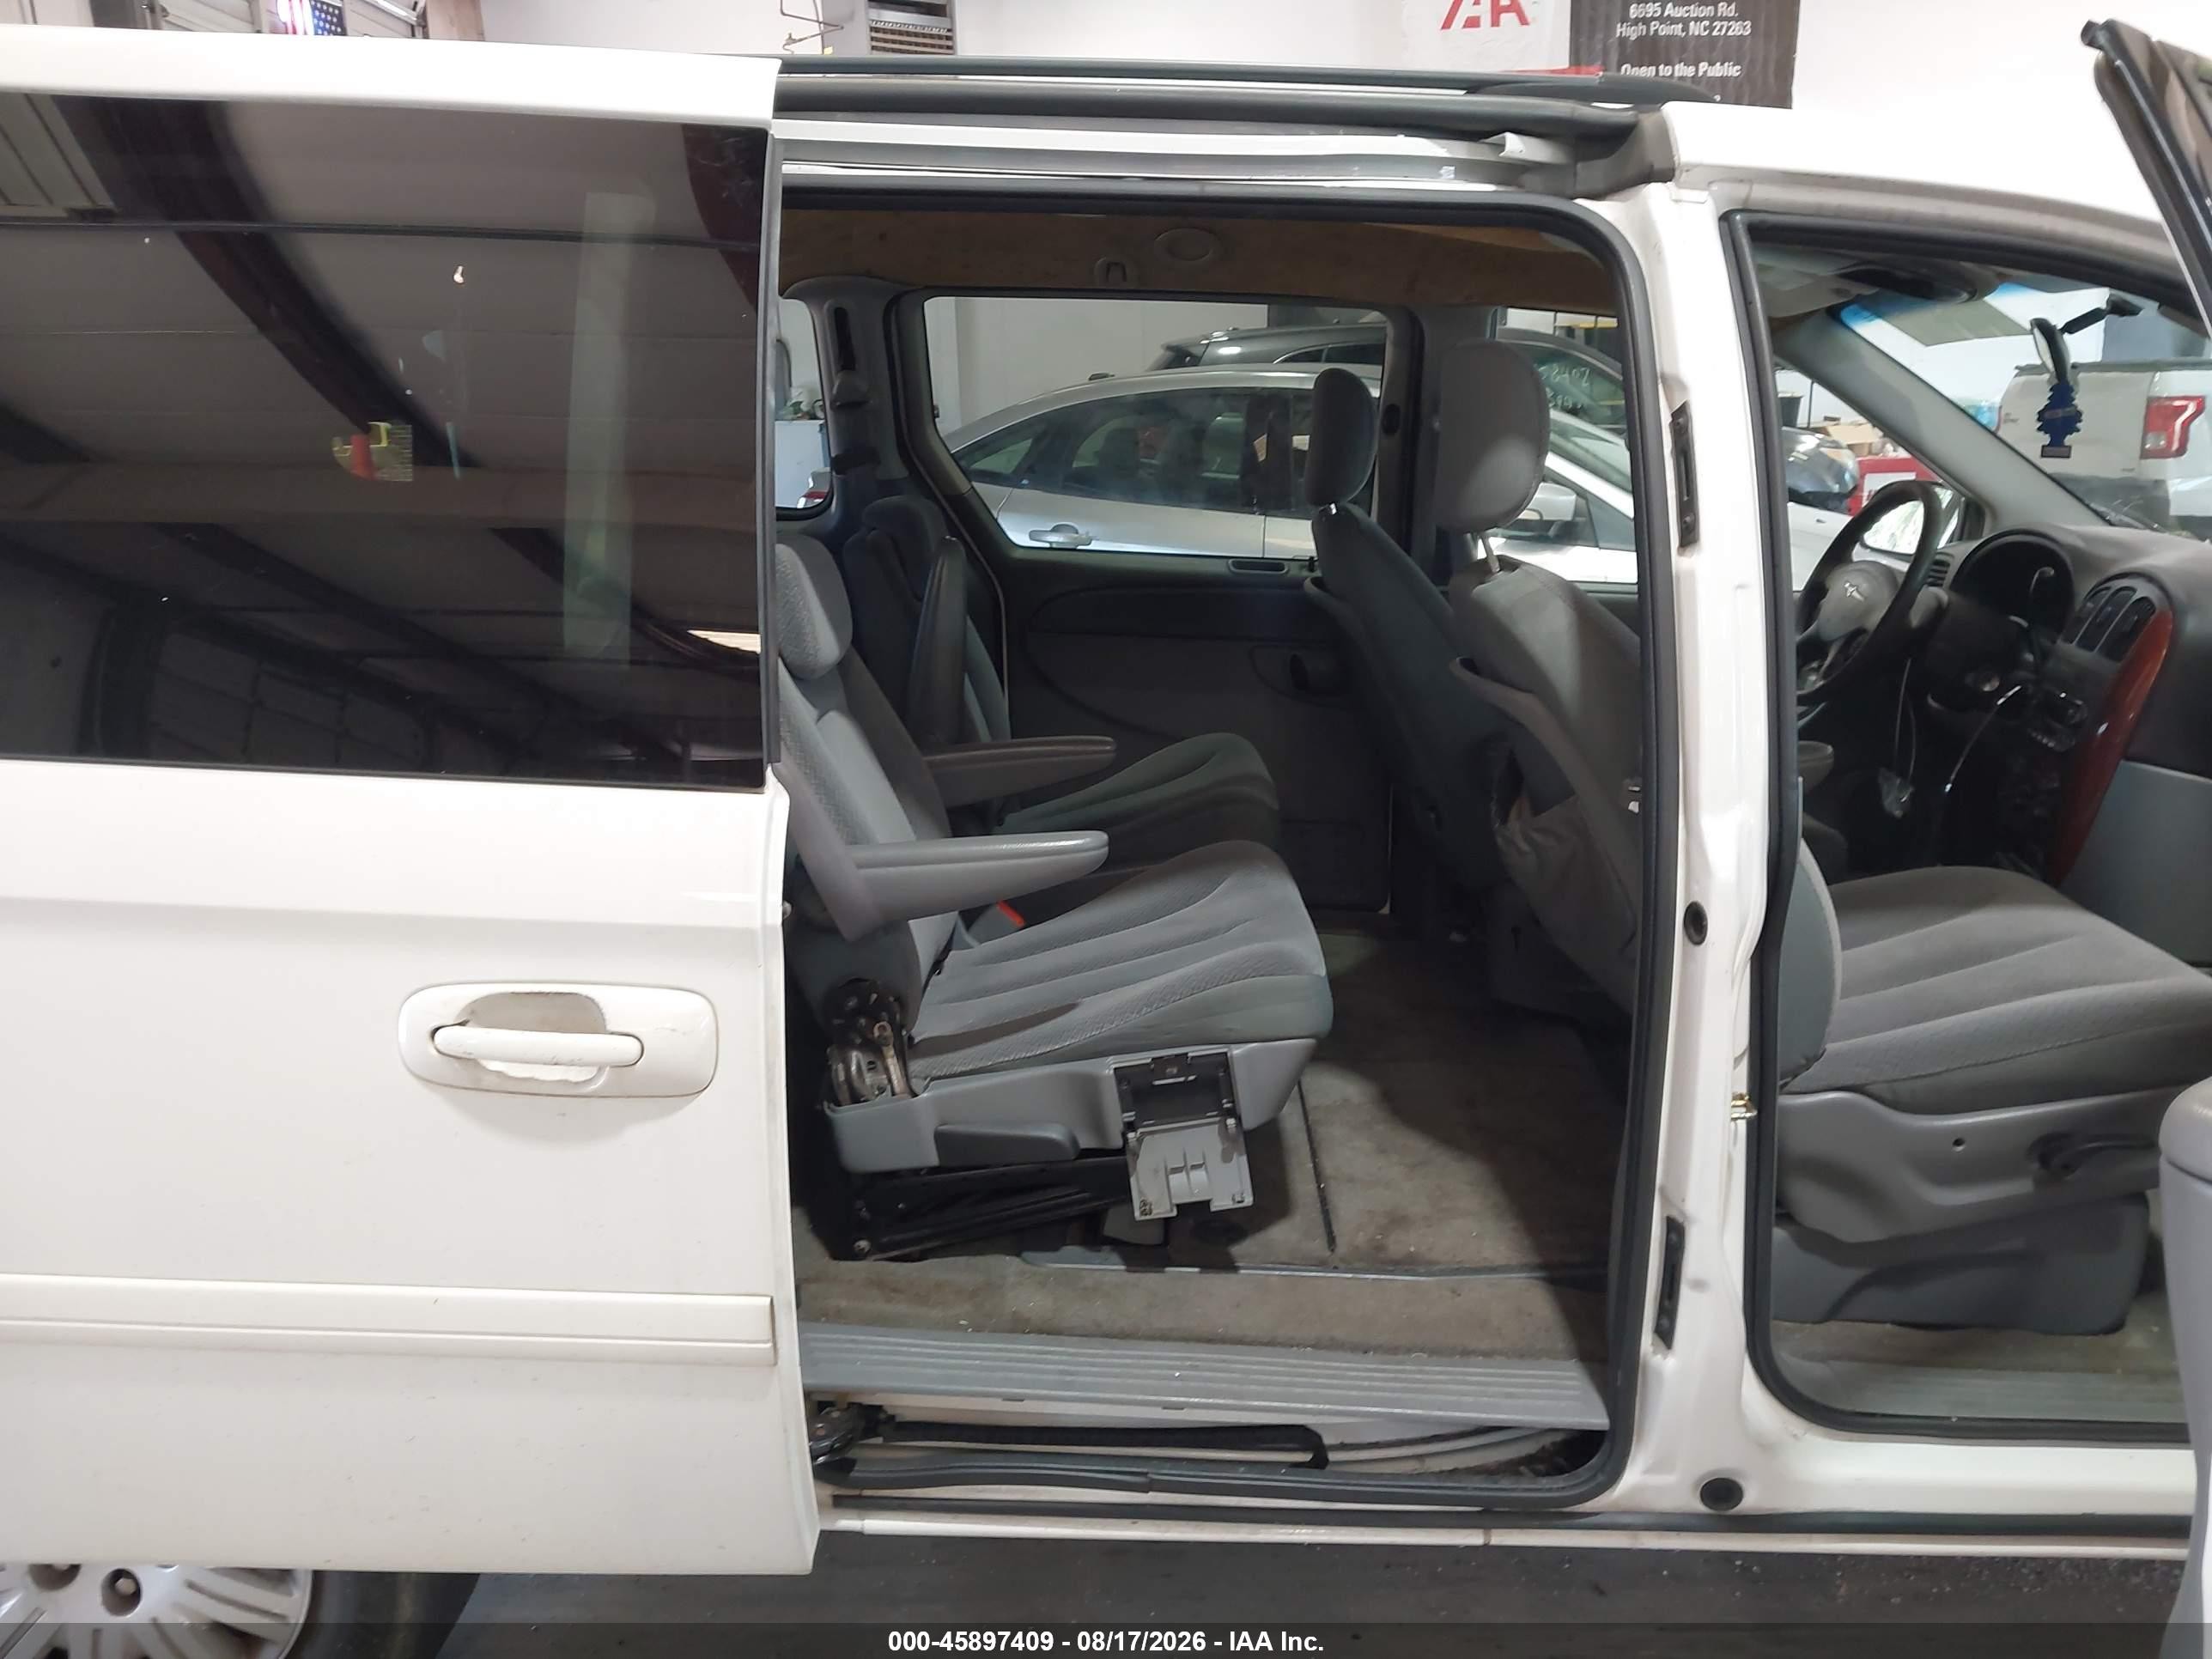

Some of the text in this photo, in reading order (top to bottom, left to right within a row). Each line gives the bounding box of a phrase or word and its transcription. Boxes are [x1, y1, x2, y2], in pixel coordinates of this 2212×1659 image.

[1629, 3, 1739, 19] 6695 Auction Rd.
[1615, 21, 1752, 40] High Point, NC 27263
[1658, 64, 1673, 76] to
[1674, 62, 1696, 76] the
[1698, 62, 1741, 77] Public
